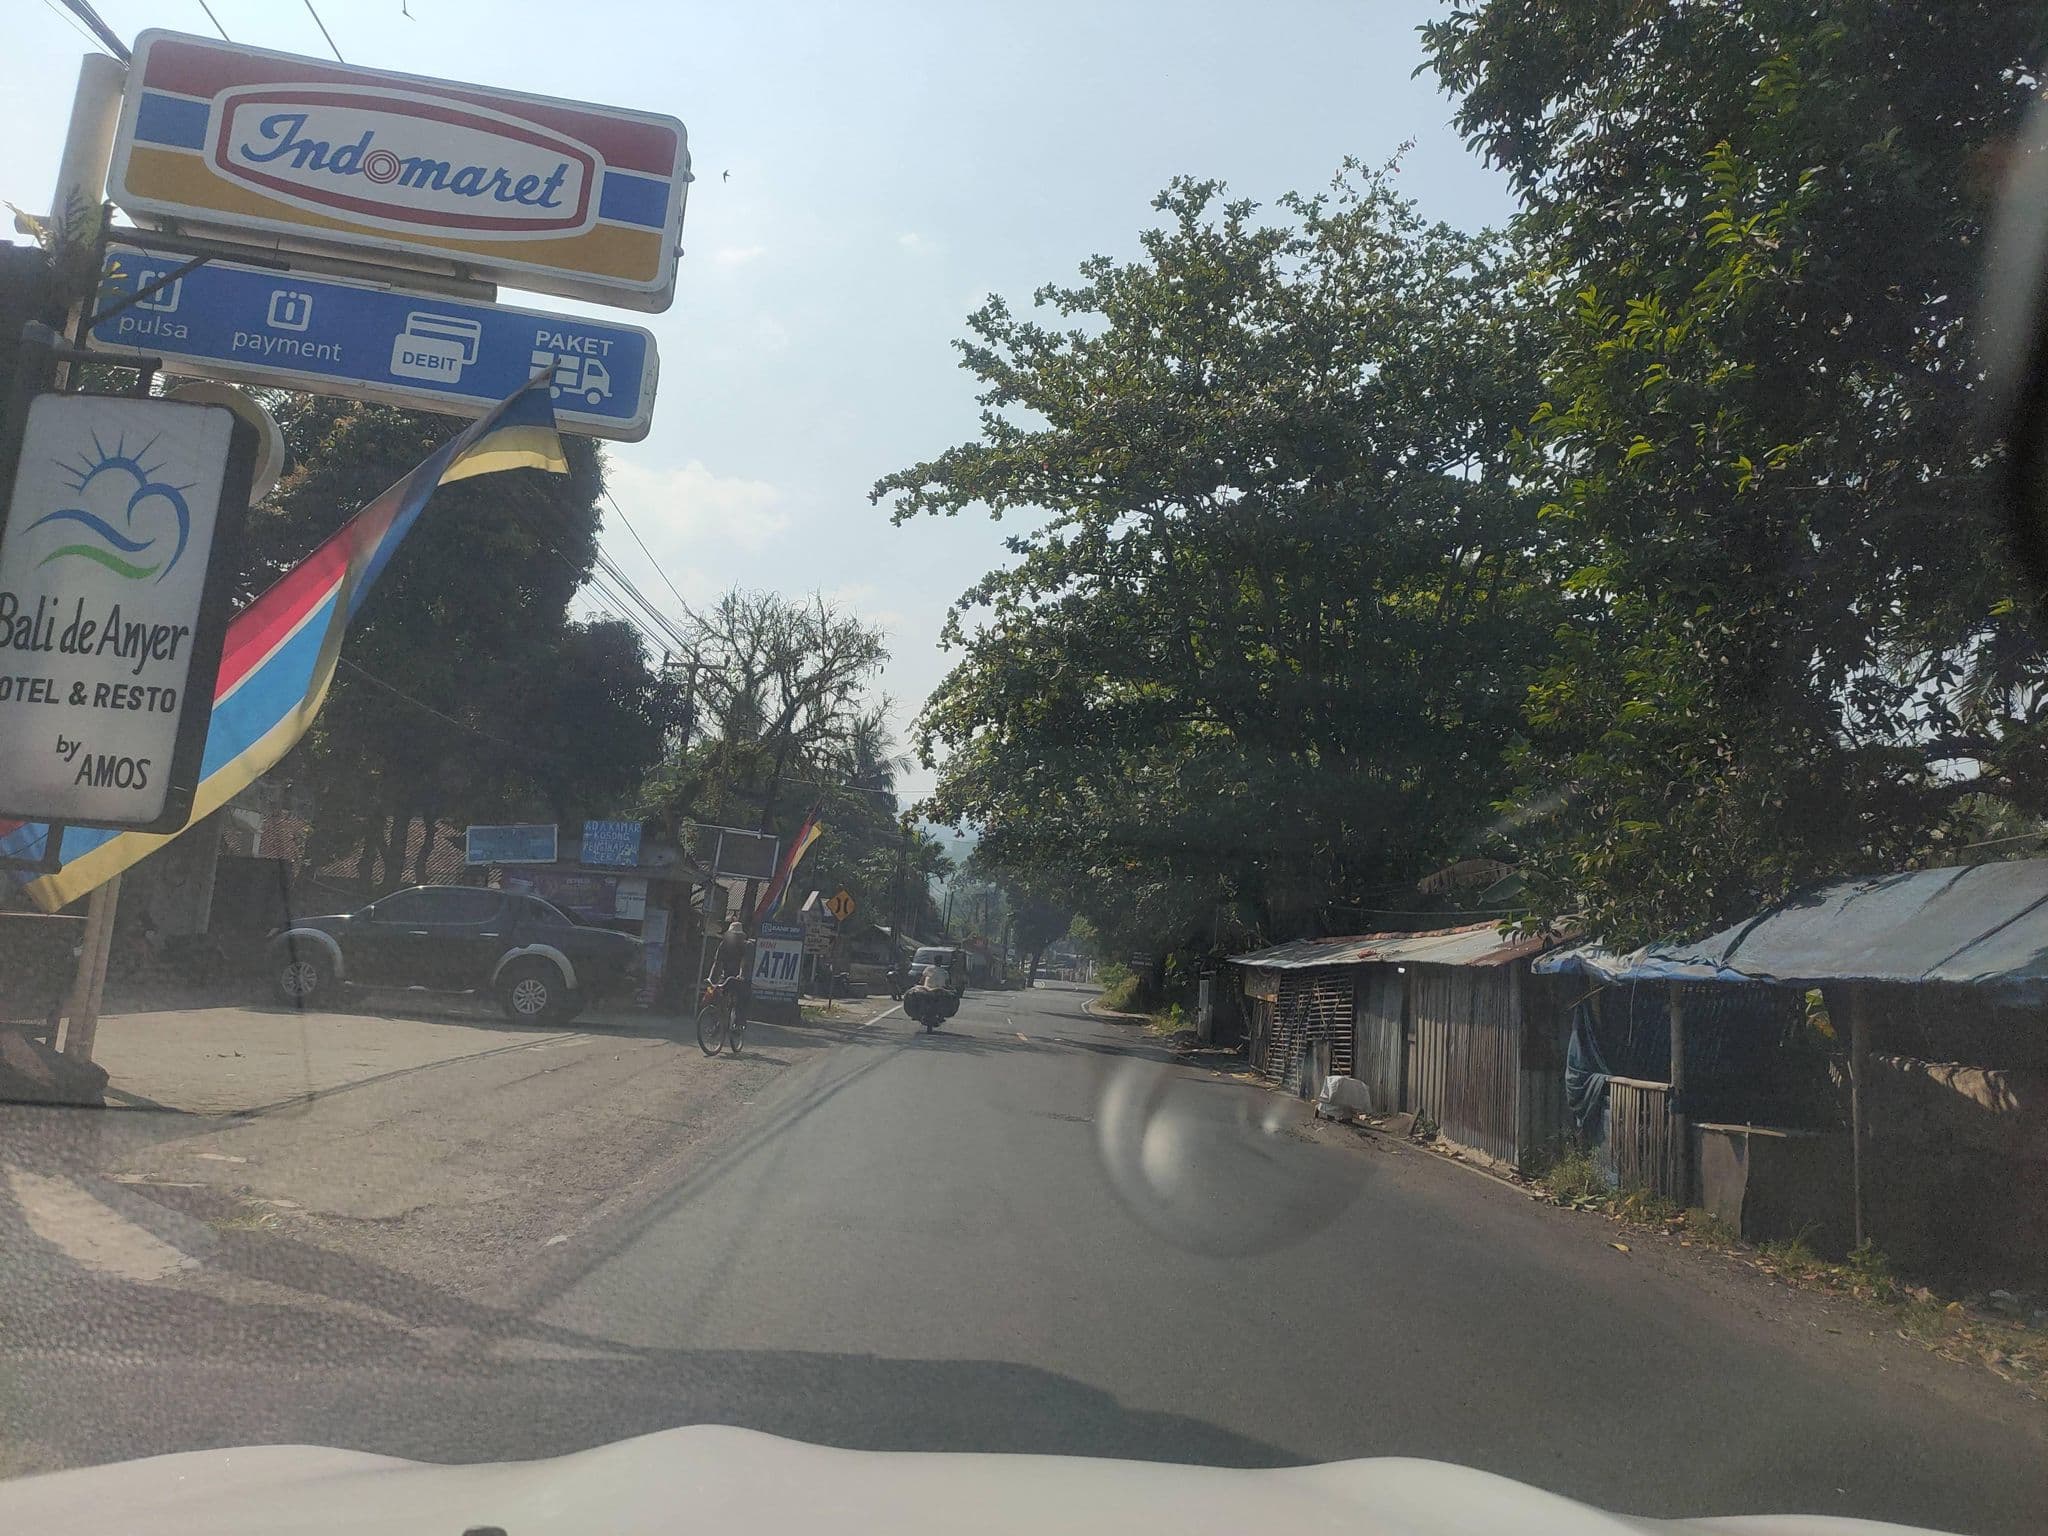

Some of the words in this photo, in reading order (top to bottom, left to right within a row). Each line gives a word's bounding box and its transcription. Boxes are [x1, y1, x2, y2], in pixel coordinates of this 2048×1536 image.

[241, 114, 569, 208] Indomaret
[119, 316, 189, 339] pulsa
[232, 331, 343, 362] payment
[536, 330, 614, 357] PAKET
[402, 351, 458, 372] DEBIT
[0, 592, 58, 651] Bali
[60, 597, 97, 654] de
[96, 604, 190, 675] Anyer
[0, 676, 60, 704] OTEL
[69, 681, 88, 706] &
[93, 682, 177, 713] RESTO
[56, 734, 81, 762] by
[74, 753, 151, 790] AMOS
[755, 950, 800, 980] ATM
